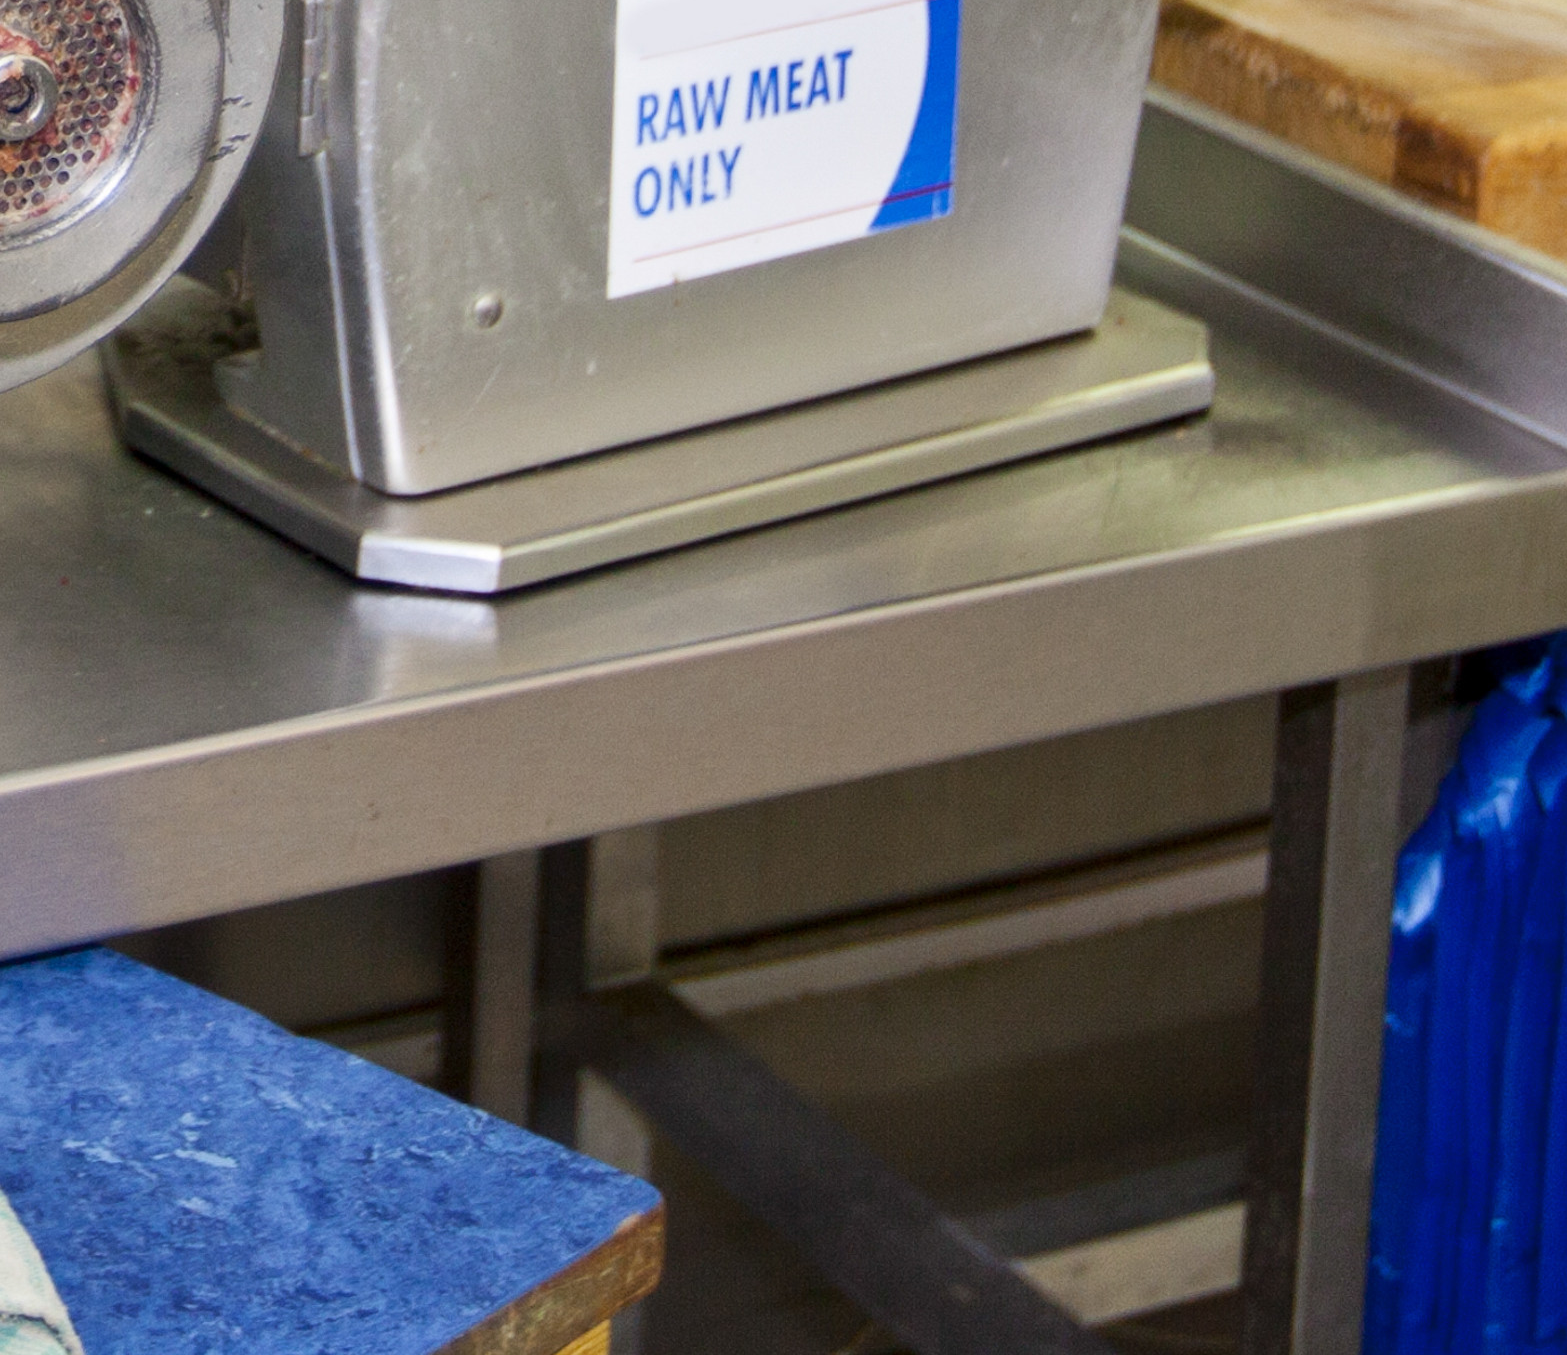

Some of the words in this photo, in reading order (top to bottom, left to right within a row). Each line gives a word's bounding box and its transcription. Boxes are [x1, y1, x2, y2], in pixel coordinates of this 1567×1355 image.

[636, 74, 731, 146] RAW
[745, 48, 853, 122] MEAT
[633, 144, 742, 219] ONLY
